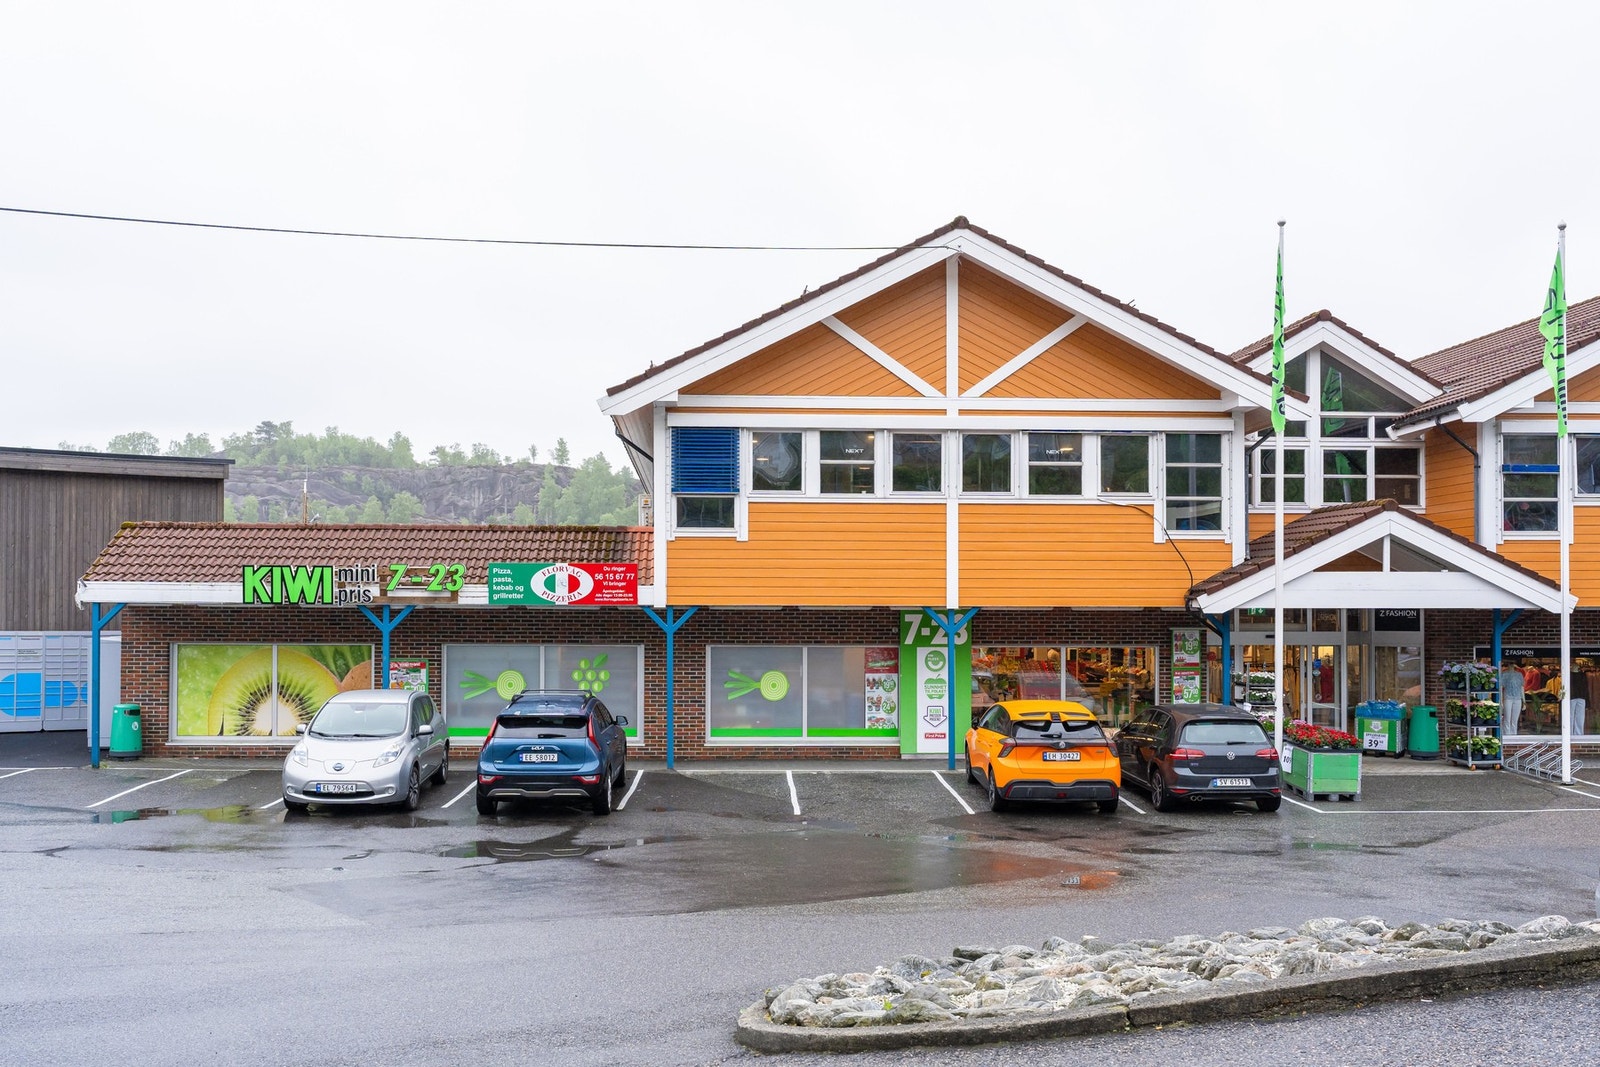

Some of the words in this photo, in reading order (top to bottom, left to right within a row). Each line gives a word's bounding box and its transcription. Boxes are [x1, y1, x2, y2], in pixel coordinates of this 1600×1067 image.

[338, 564, 376, 582] mini
[243, 565, 333, 604] KIWI
[338, 585, 373, 606] pris
[541, 590, 583, 602] PIZZERIA
